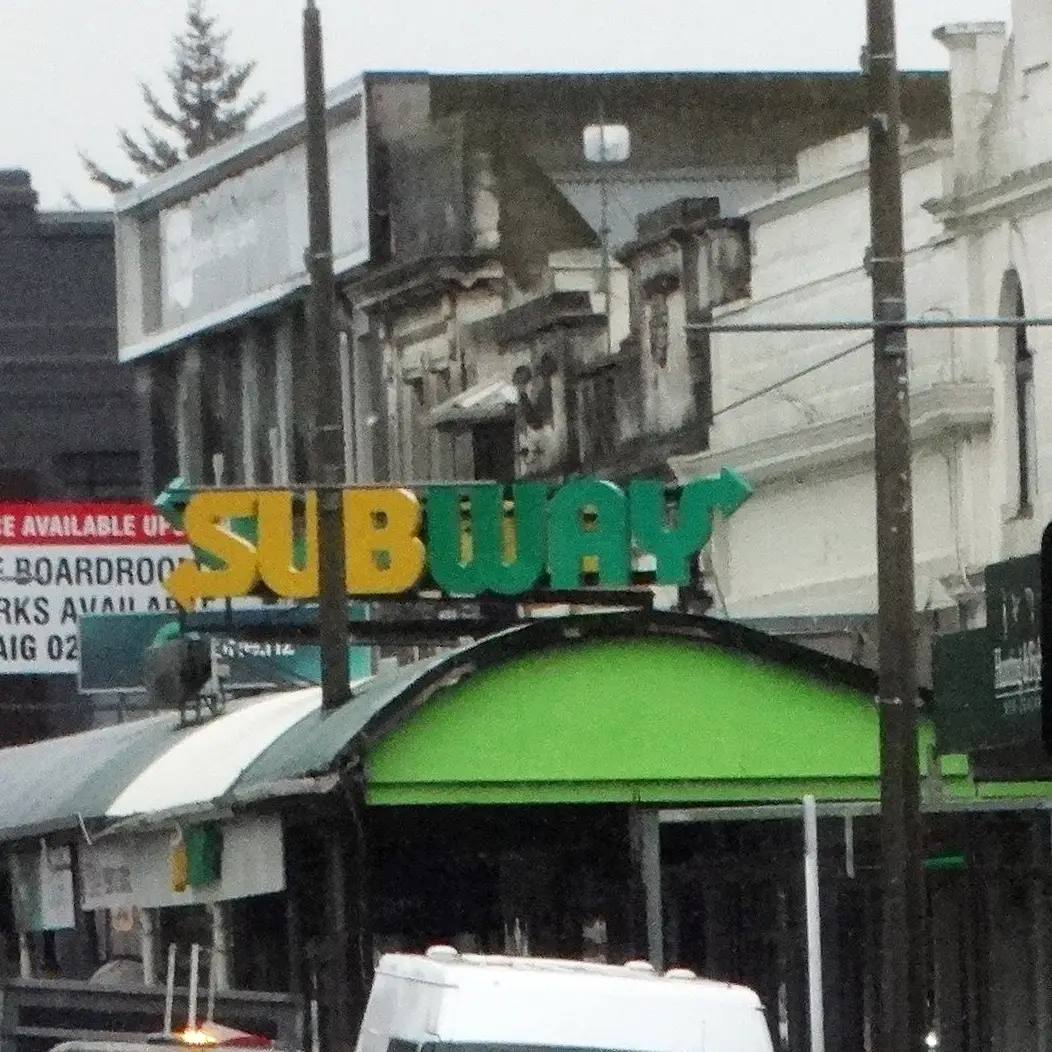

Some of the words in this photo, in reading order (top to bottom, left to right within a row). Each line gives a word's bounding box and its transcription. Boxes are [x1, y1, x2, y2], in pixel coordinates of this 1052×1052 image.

[0, 513, 16, 538] E
[21, 513, 137, 537] AVAILABLE
[162, 467, 753, 612] SUBWAY
[15, 556, 201, 586] BOARDROO
[60, 595, 214, 624] AVAILA
[47, 634, 79, 660] 02
